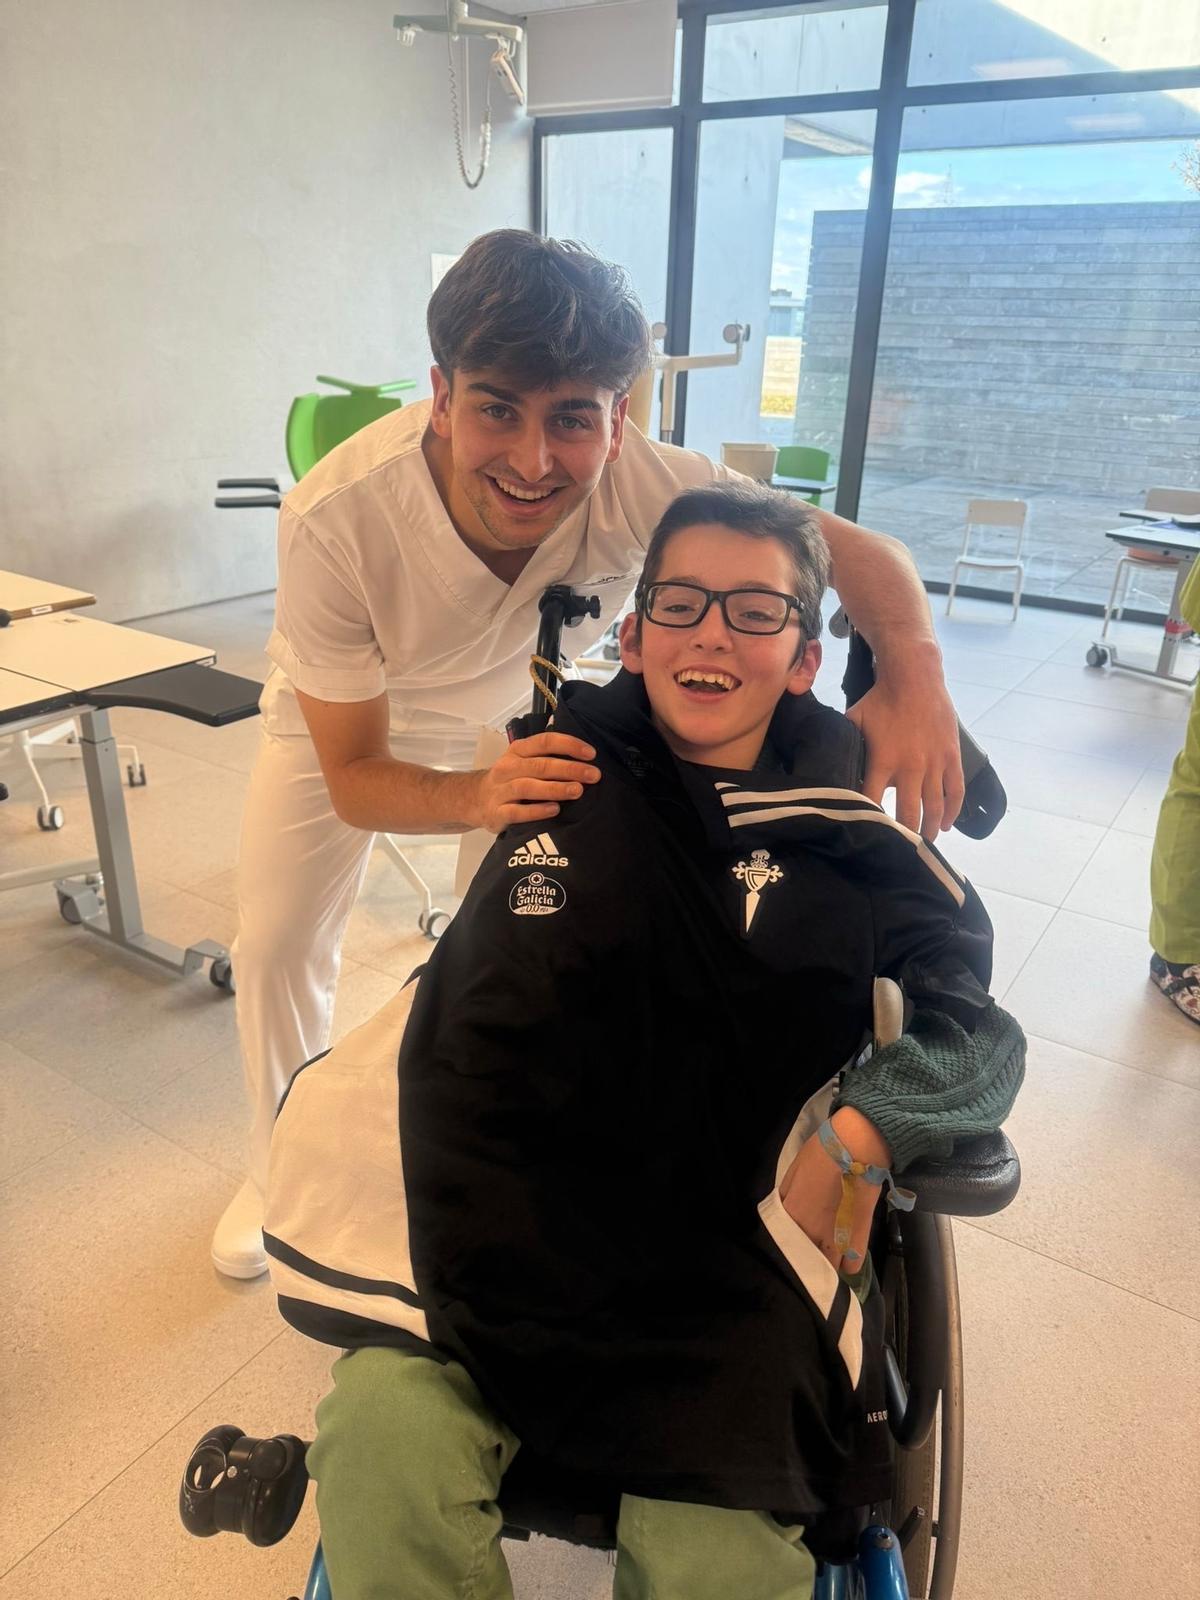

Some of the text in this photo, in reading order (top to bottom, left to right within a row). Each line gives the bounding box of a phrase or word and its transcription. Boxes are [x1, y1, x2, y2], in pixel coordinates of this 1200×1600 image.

[508, 854, 569, 868] adidas
[517, 885, 556, 896] Estrella
[516, 895, 554, 906] Galicia
